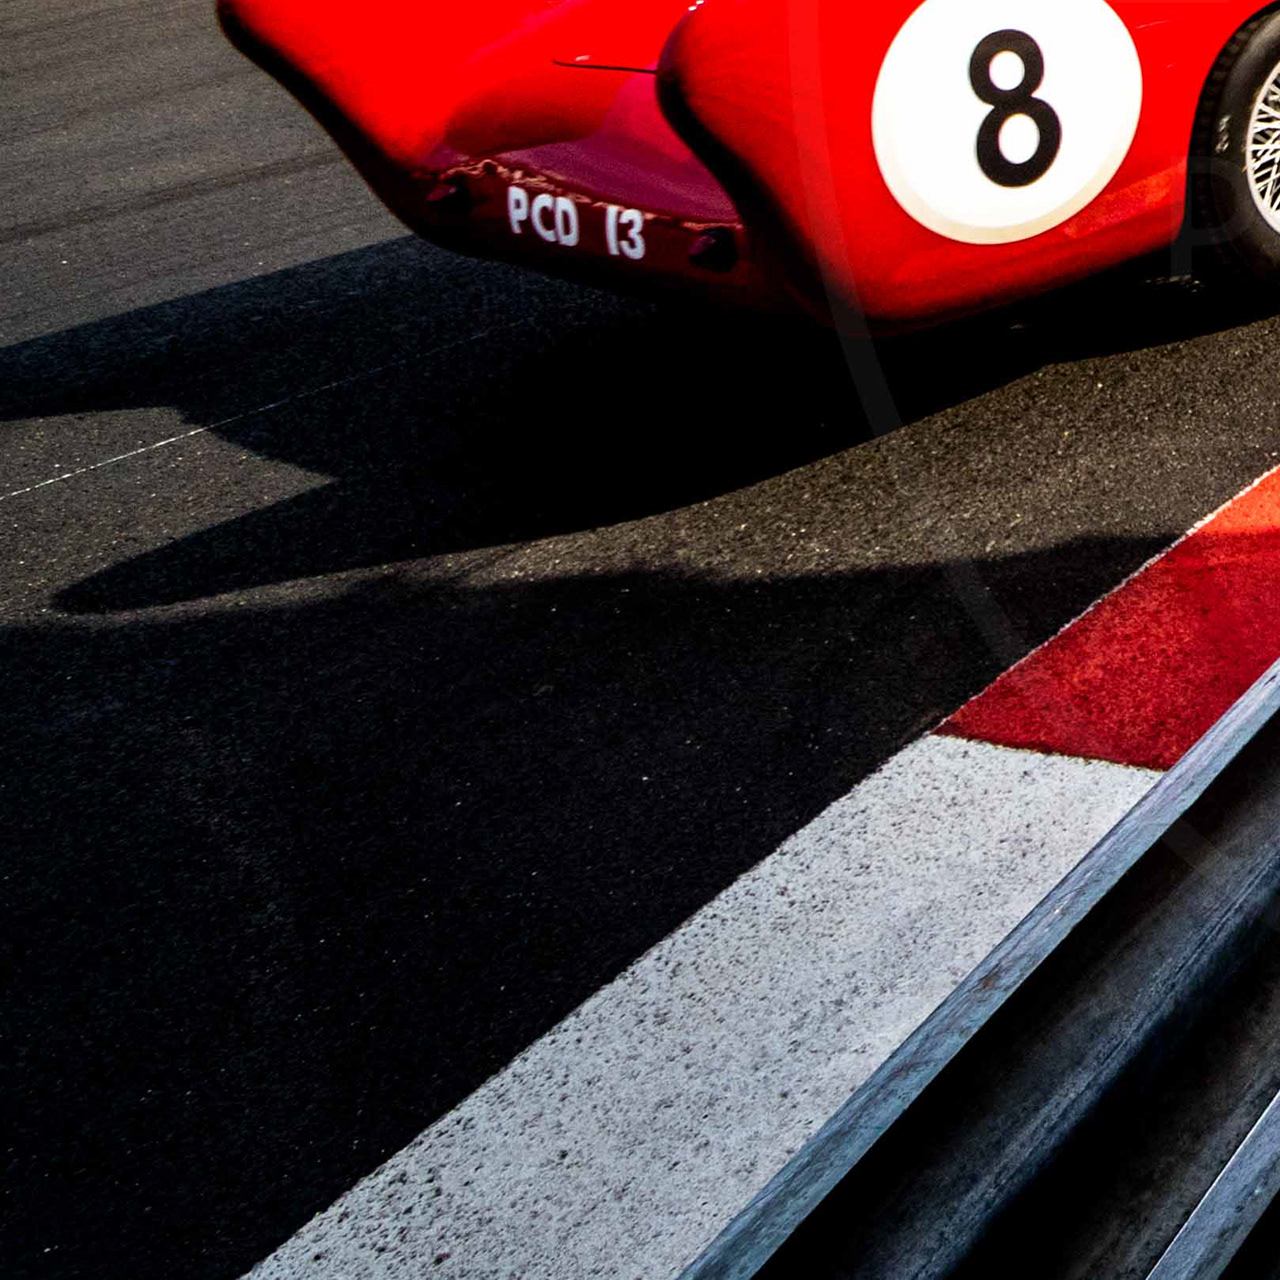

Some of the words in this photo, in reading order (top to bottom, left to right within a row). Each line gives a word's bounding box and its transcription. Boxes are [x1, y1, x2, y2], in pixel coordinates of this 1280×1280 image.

[967, 28, 1062, 188] 8
[507, 186, 580, 247] PCD
[605, 204, 646, 260] 13
